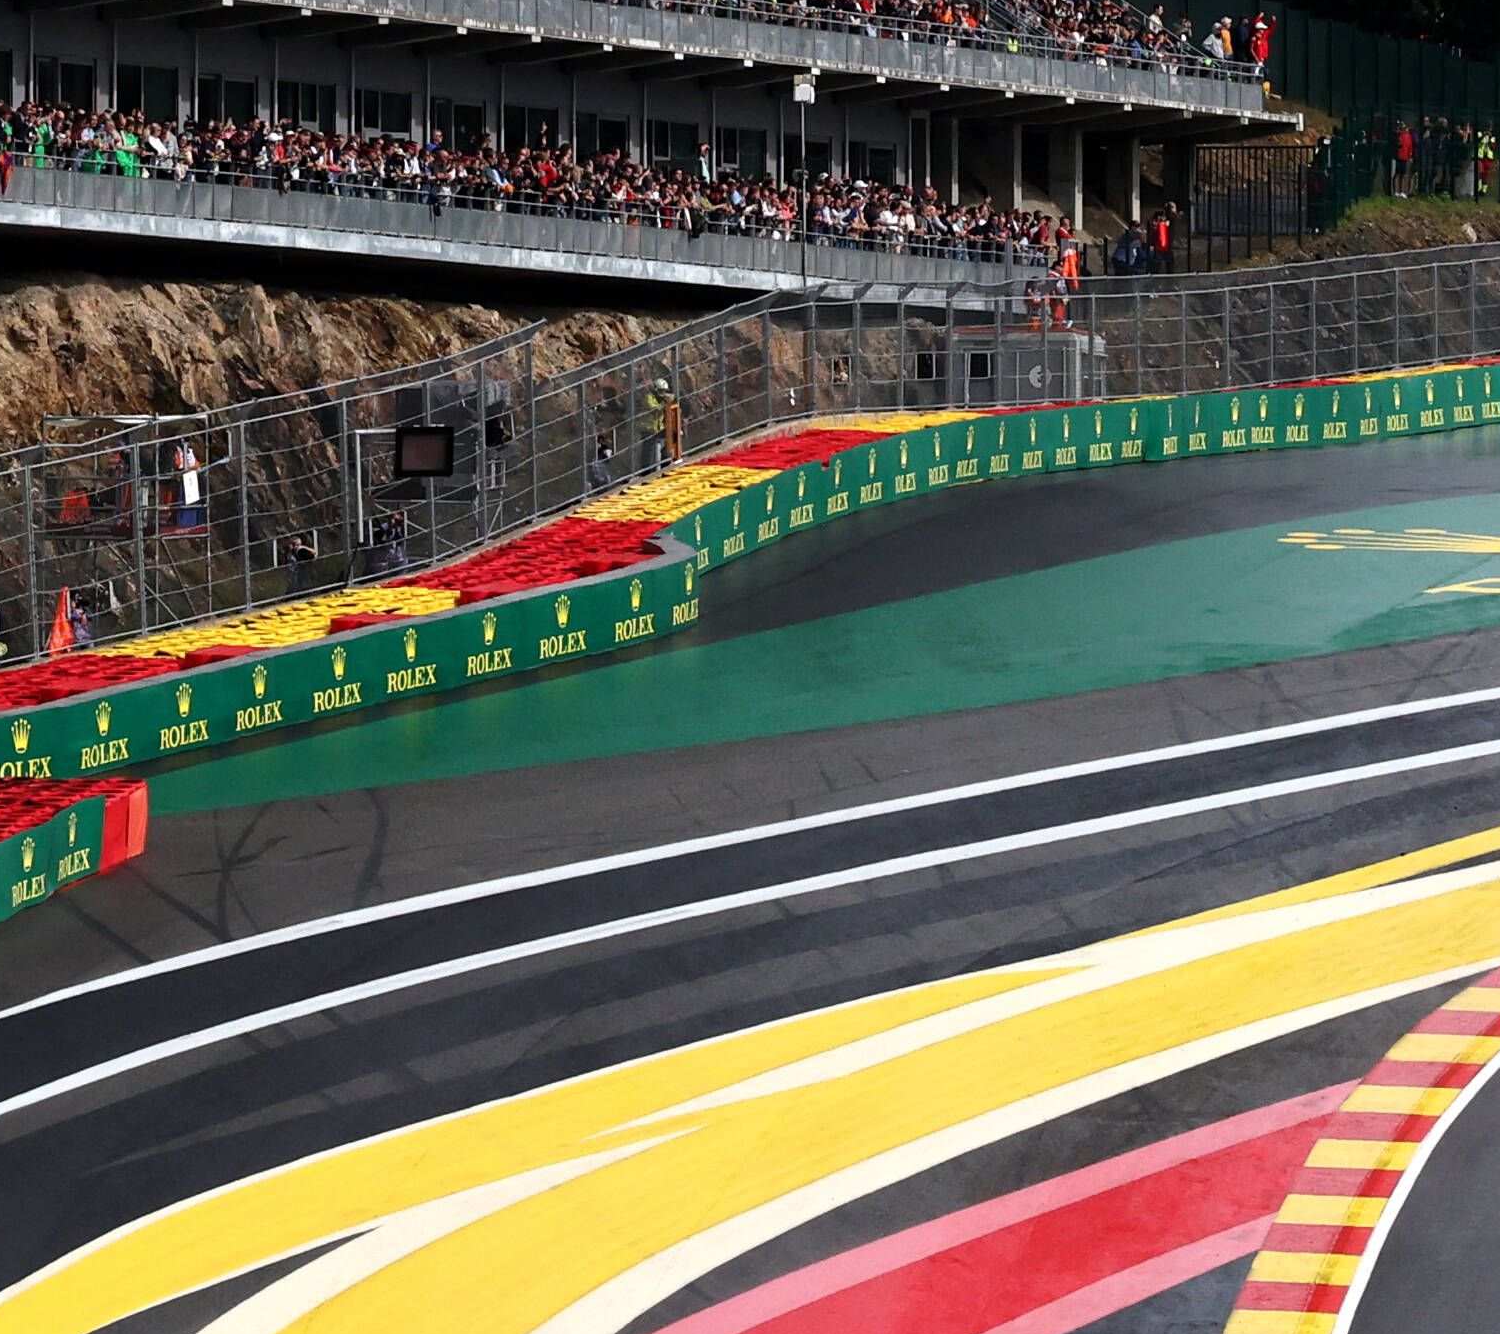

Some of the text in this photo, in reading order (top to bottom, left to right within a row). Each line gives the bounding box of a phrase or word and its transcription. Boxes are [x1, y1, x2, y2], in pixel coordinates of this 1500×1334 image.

[1222, 429, 1246, 447] ROLEX
[1252, 427, 1275, 443] ROLEX
[1286, 425, 1309, 442] ROLEX
[790, 504, 814, 528] ROLEX
[698, 547, 709, 569] LEX
[615, 614, 654, 642] ROLEX
[539, 630, 586, 659] ROLEX
[466, 648, 512, 677] ROLEX
[387, 664, 436, 693] ROLEX
[313, 683, 361, 713] ROLEX
[236, 701, 282, 731] ROLEX
[160, 720, 209, 750] ROLEX
[81, 738, 129, 769] ROLEX
[57, 848, 91, 881] ROLEX
[12, 874, 46, 907] ROLEX
